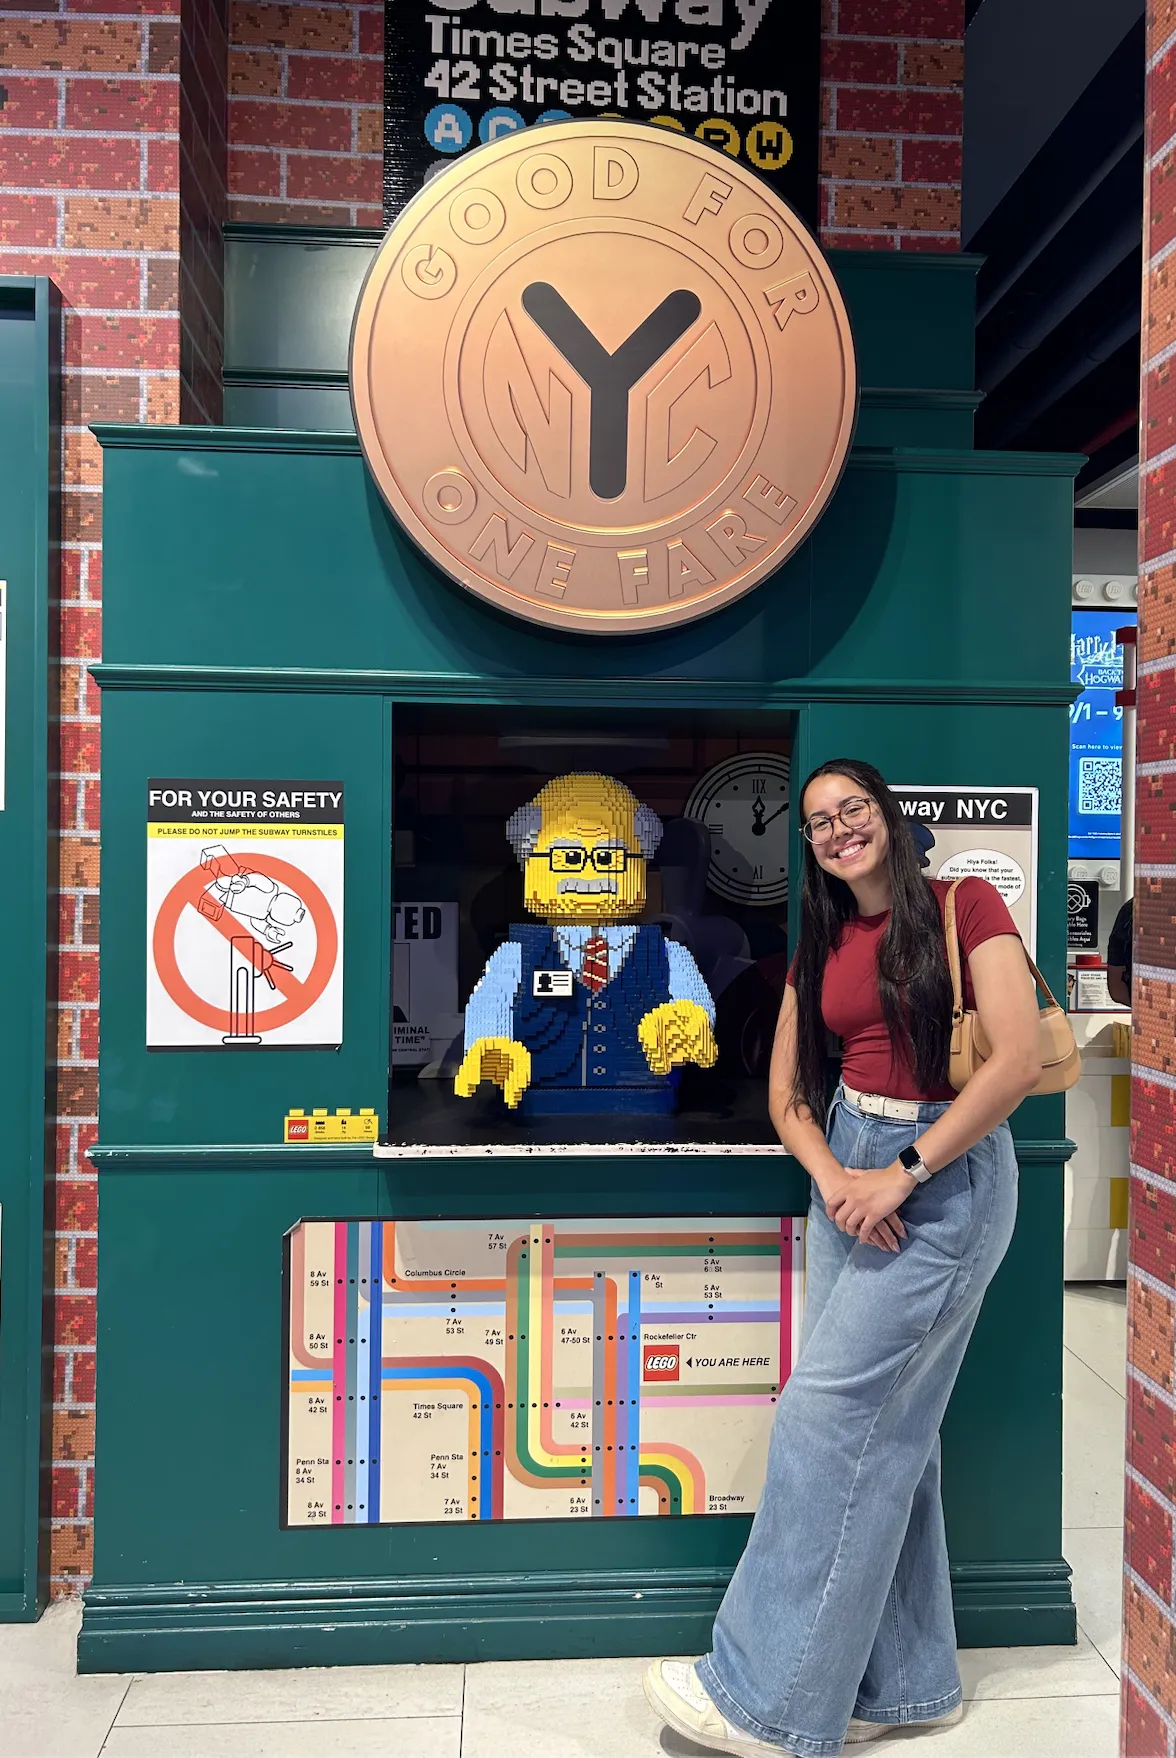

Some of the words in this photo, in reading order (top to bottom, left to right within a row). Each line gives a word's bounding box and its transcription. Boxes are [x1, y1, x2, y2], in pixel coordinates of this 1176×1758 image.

[425, 15, 558, 60] Times
[567, 23, 725, 69] Square
[424, 59, 480, 99] 42
[489, 62, 628, 107] Street
[637, 71, 787, 116] Station
[434, 113, 462, 144] A
[756, 131, 783, 160] W
[401, 145, 640, 300] GOOD
[682, 172, 819, 331] FOR
[483, 281, 732, 504] NYC
[422, 466, 576, 599] ONE
[617, 474, 798, 605] FARE
[149, 790, 192, 807] FOR
[197, 790, 257, 808] YOUR
[262, 791, 343, 808] SAFETY
[191, 810, 208, 818] AND
[269, 811, 300, 819] OTHERS
[957, 799, 1008, 819] NYC
[291, 1125, 307, 1133] LEGO
[405, 1269, 442, 1277] Columbus
[444, 1269, 466, 1277] Circle
[646, 1355, 678, 1370] LEGO
[695, 1358, 716, 1366] YOU
[718, 1358, 740, 1366] ARE
[742, 1358, 770, 1366] HERE
[709, 1494, 744, 1502] Broadway
